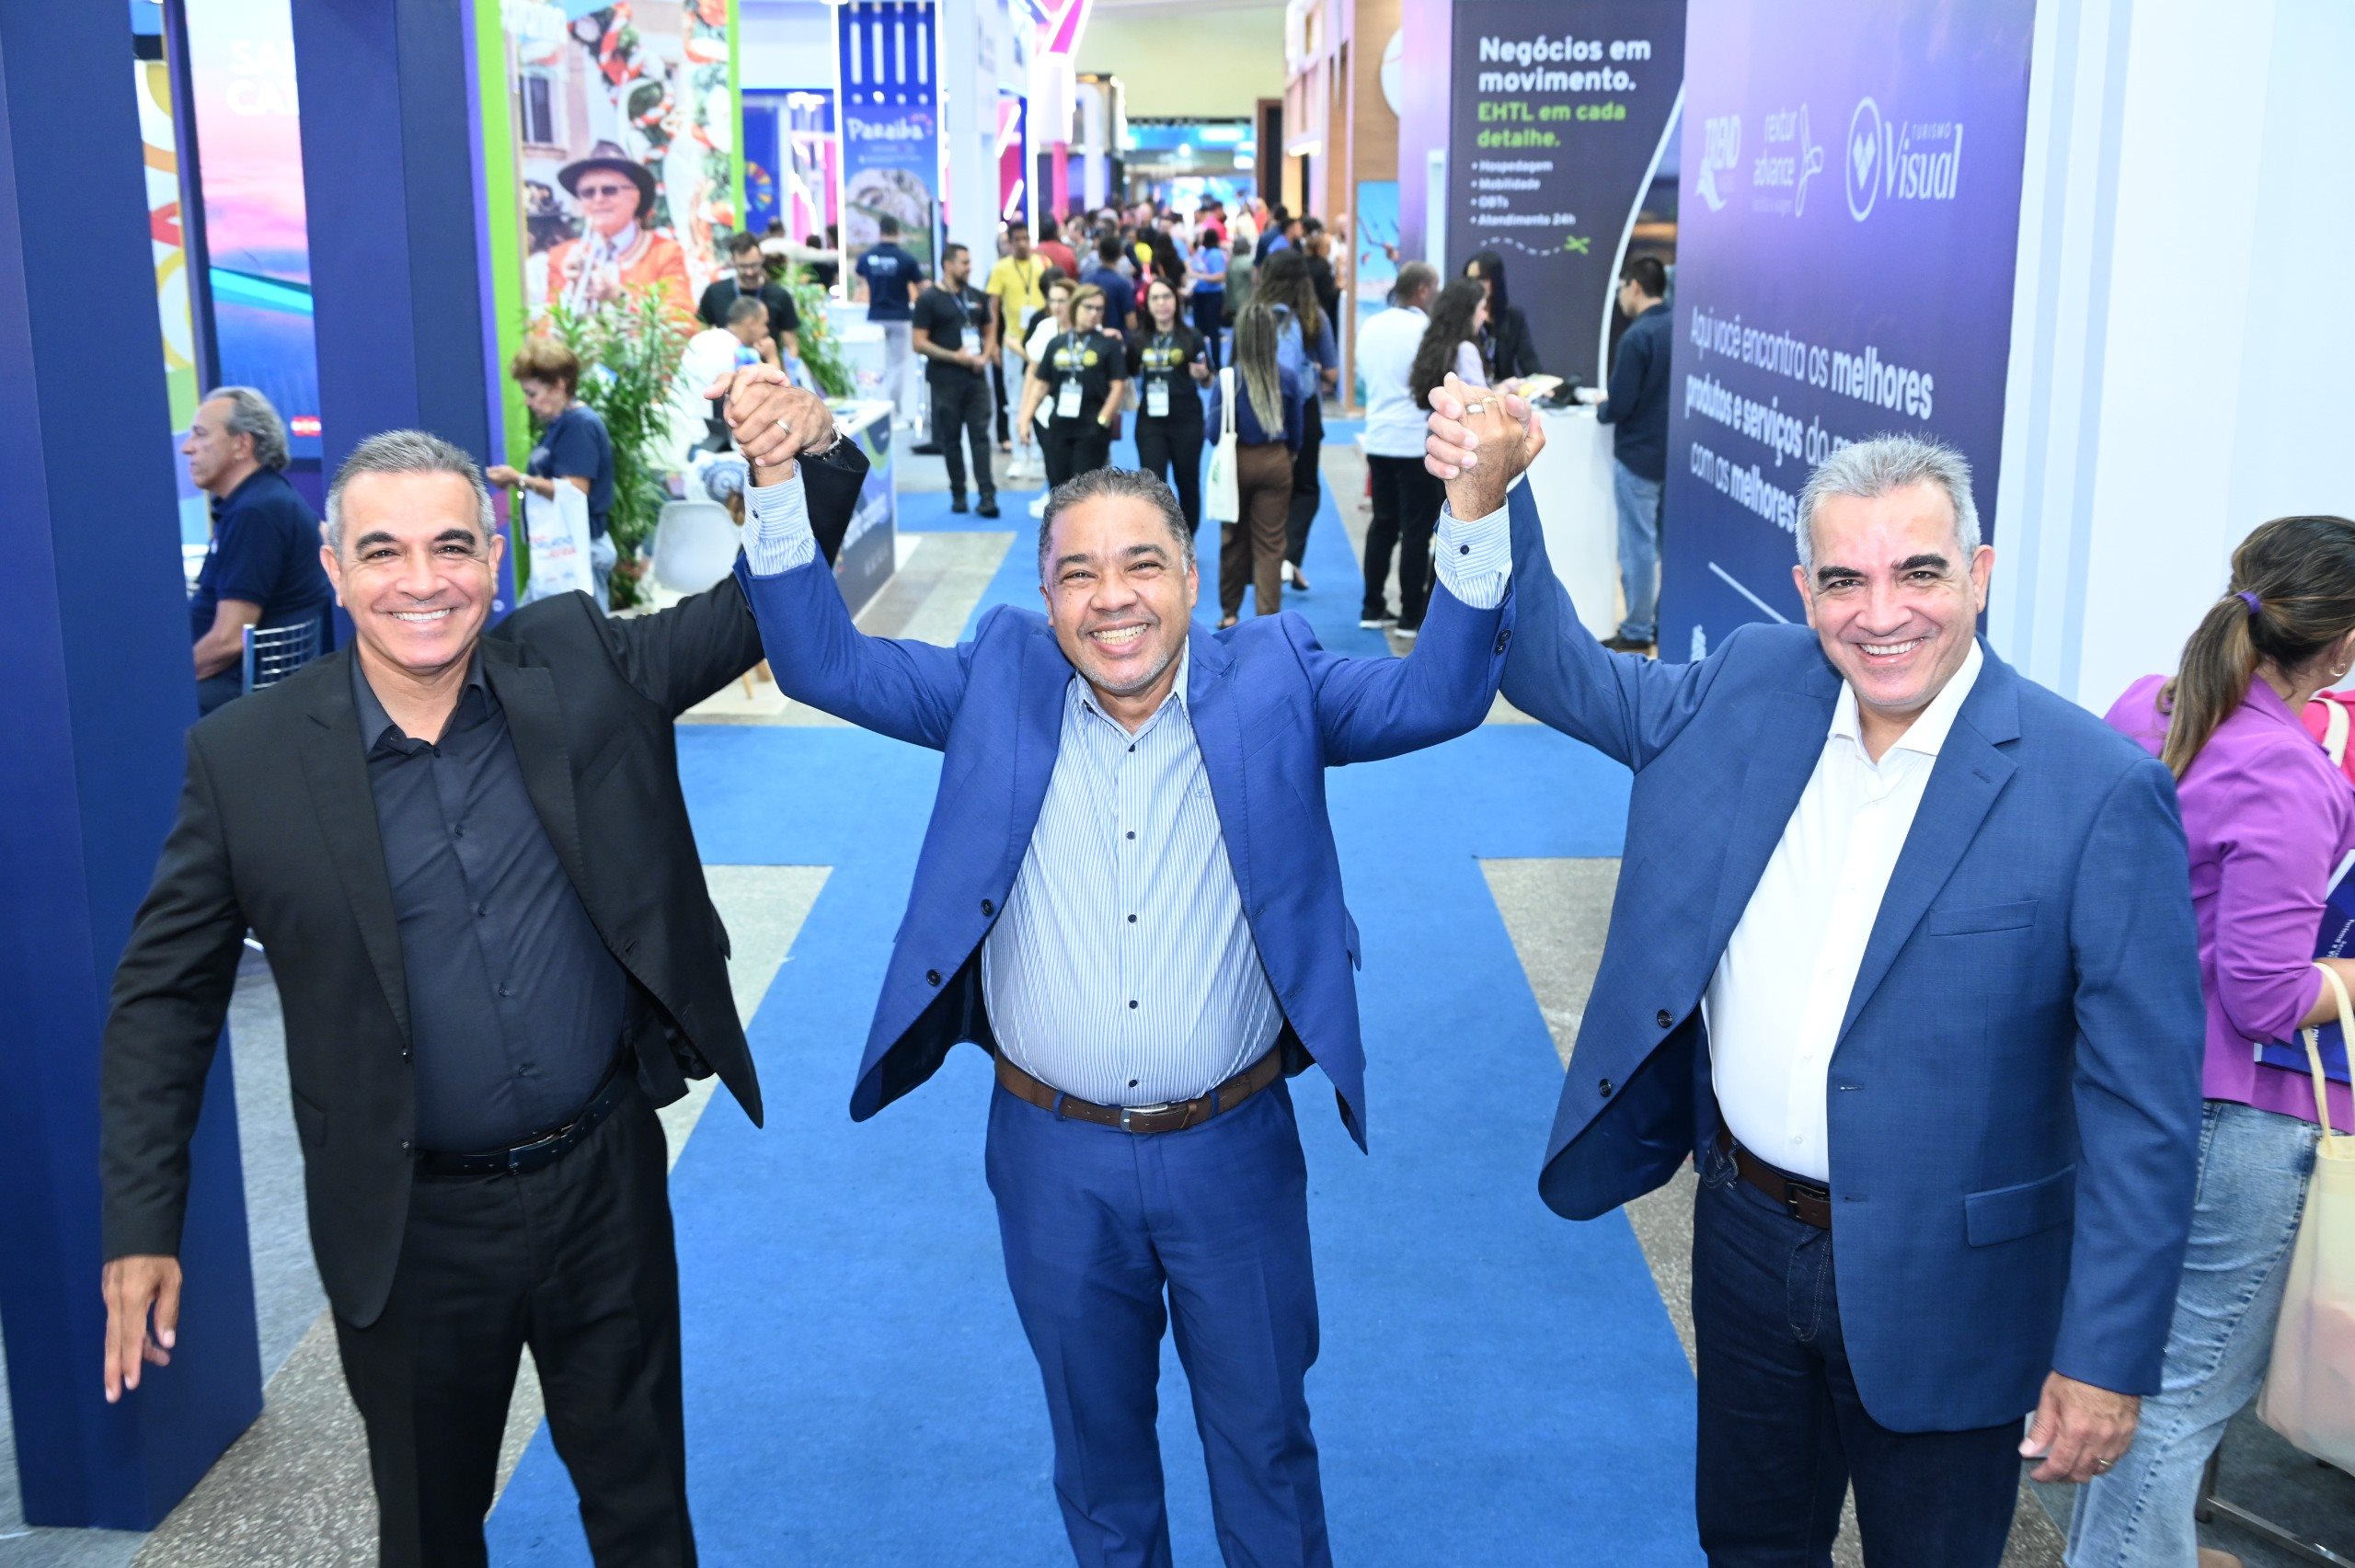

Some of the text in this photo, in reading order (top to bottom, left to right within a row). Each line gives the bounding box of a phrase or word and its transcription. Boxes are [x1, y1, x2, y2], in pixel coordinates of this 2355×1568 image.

[1479, 35, 1651, 67] Negócios em
[1478, 65, 1637, 91] movimento.
[1477, 101, 1626, 121] EHTL em cada
[1476, 128, 1561, 147] detalhe.
[1885, 120, 1963, 200] Visual
[1741, 326, 1806, 381] encontra
[1808, 345, 1830, 388] os
[1831, 345, 1934, 420] melhores
[1732, 395, 1742, 430] e
[1741, 395, 1804, 468] serviços
[1805, 414, 1830, 466] do
[1690, 441, 1797, 534] com os melhores
